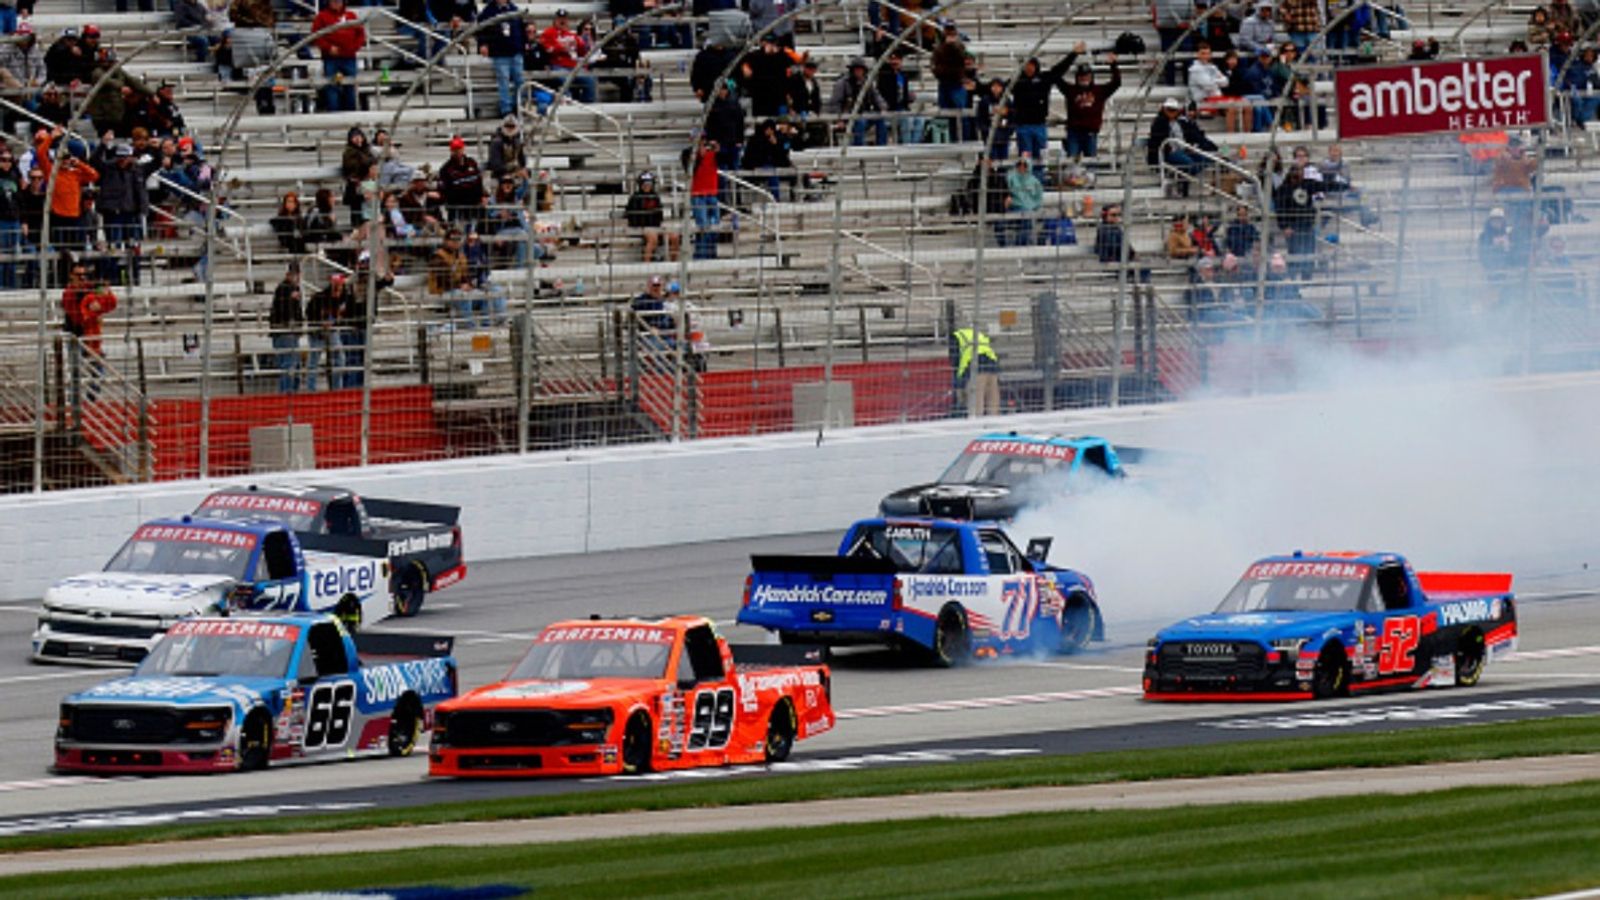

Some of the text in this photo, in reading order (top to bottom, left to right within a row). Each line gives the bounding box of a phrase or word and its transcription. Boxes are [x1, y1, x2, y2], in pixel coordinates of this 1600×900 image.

[1350, 62, 1532, 120] ambetter
[1449, 111, 1530, 130] HEALTH
[970, 440, 1069, 458] CRAFTSMAN
[206, 495, 309, 513] CRAFTSMAN
[141, 526, 247, 546] CRAFTSMAN
[313, 560, 376, 598] telcel
[1250, 563, 1357, 578] CRAFTSMAN
[253, 582, 301, 612] 77
[1000, 575, 1038, 640] 71
[173, 621, 288, 637] CRAFTSMAN
[543, 627, 663, 643] CRAFTSMAN
[1186, 643, 1235, 655] TOYOTA
[1378, 614, 1421, 675] 52
[303, 679, 356, 751] 66
[686, 686, 735, 754] 99
